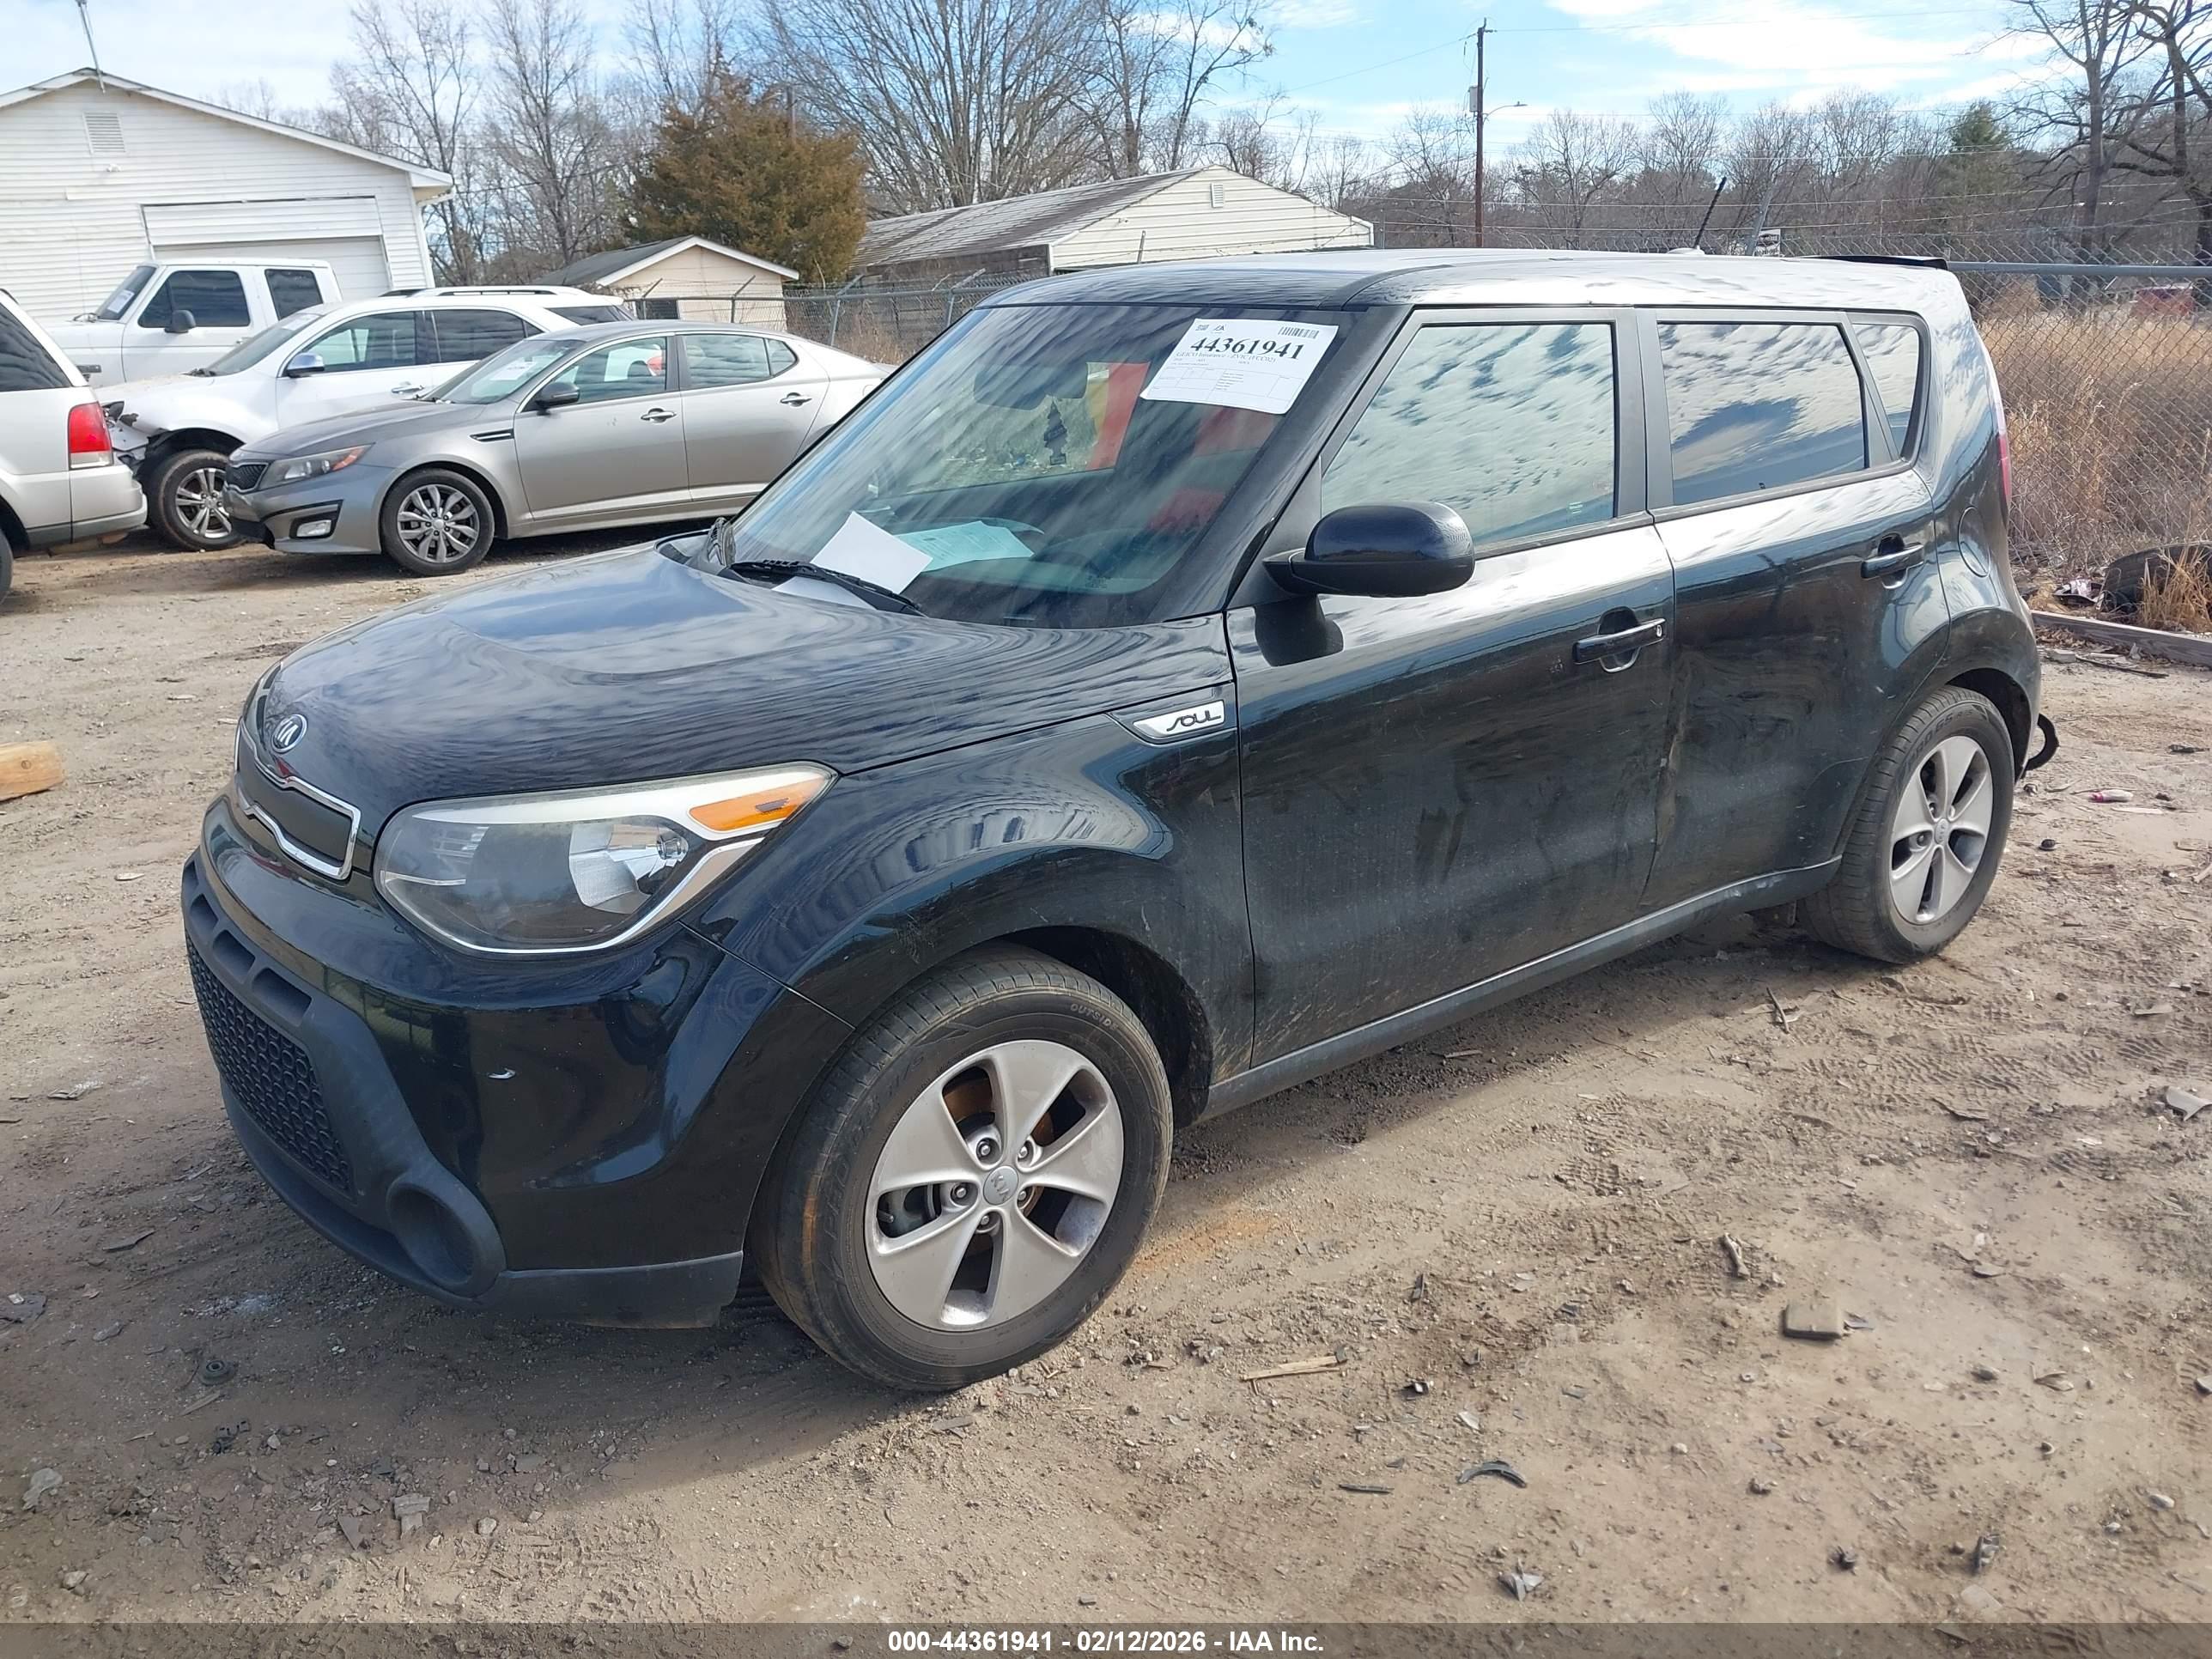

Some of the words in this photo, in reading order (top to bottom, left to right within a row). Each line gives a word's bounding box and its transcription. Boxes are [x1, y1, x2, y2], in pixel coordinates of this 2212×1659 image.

[1190, 337, 1304, 360] 44361941
[1166, 710, 1221, 732] SOUL
[1070, 1003, 1119, 1030] OUTSIDE
